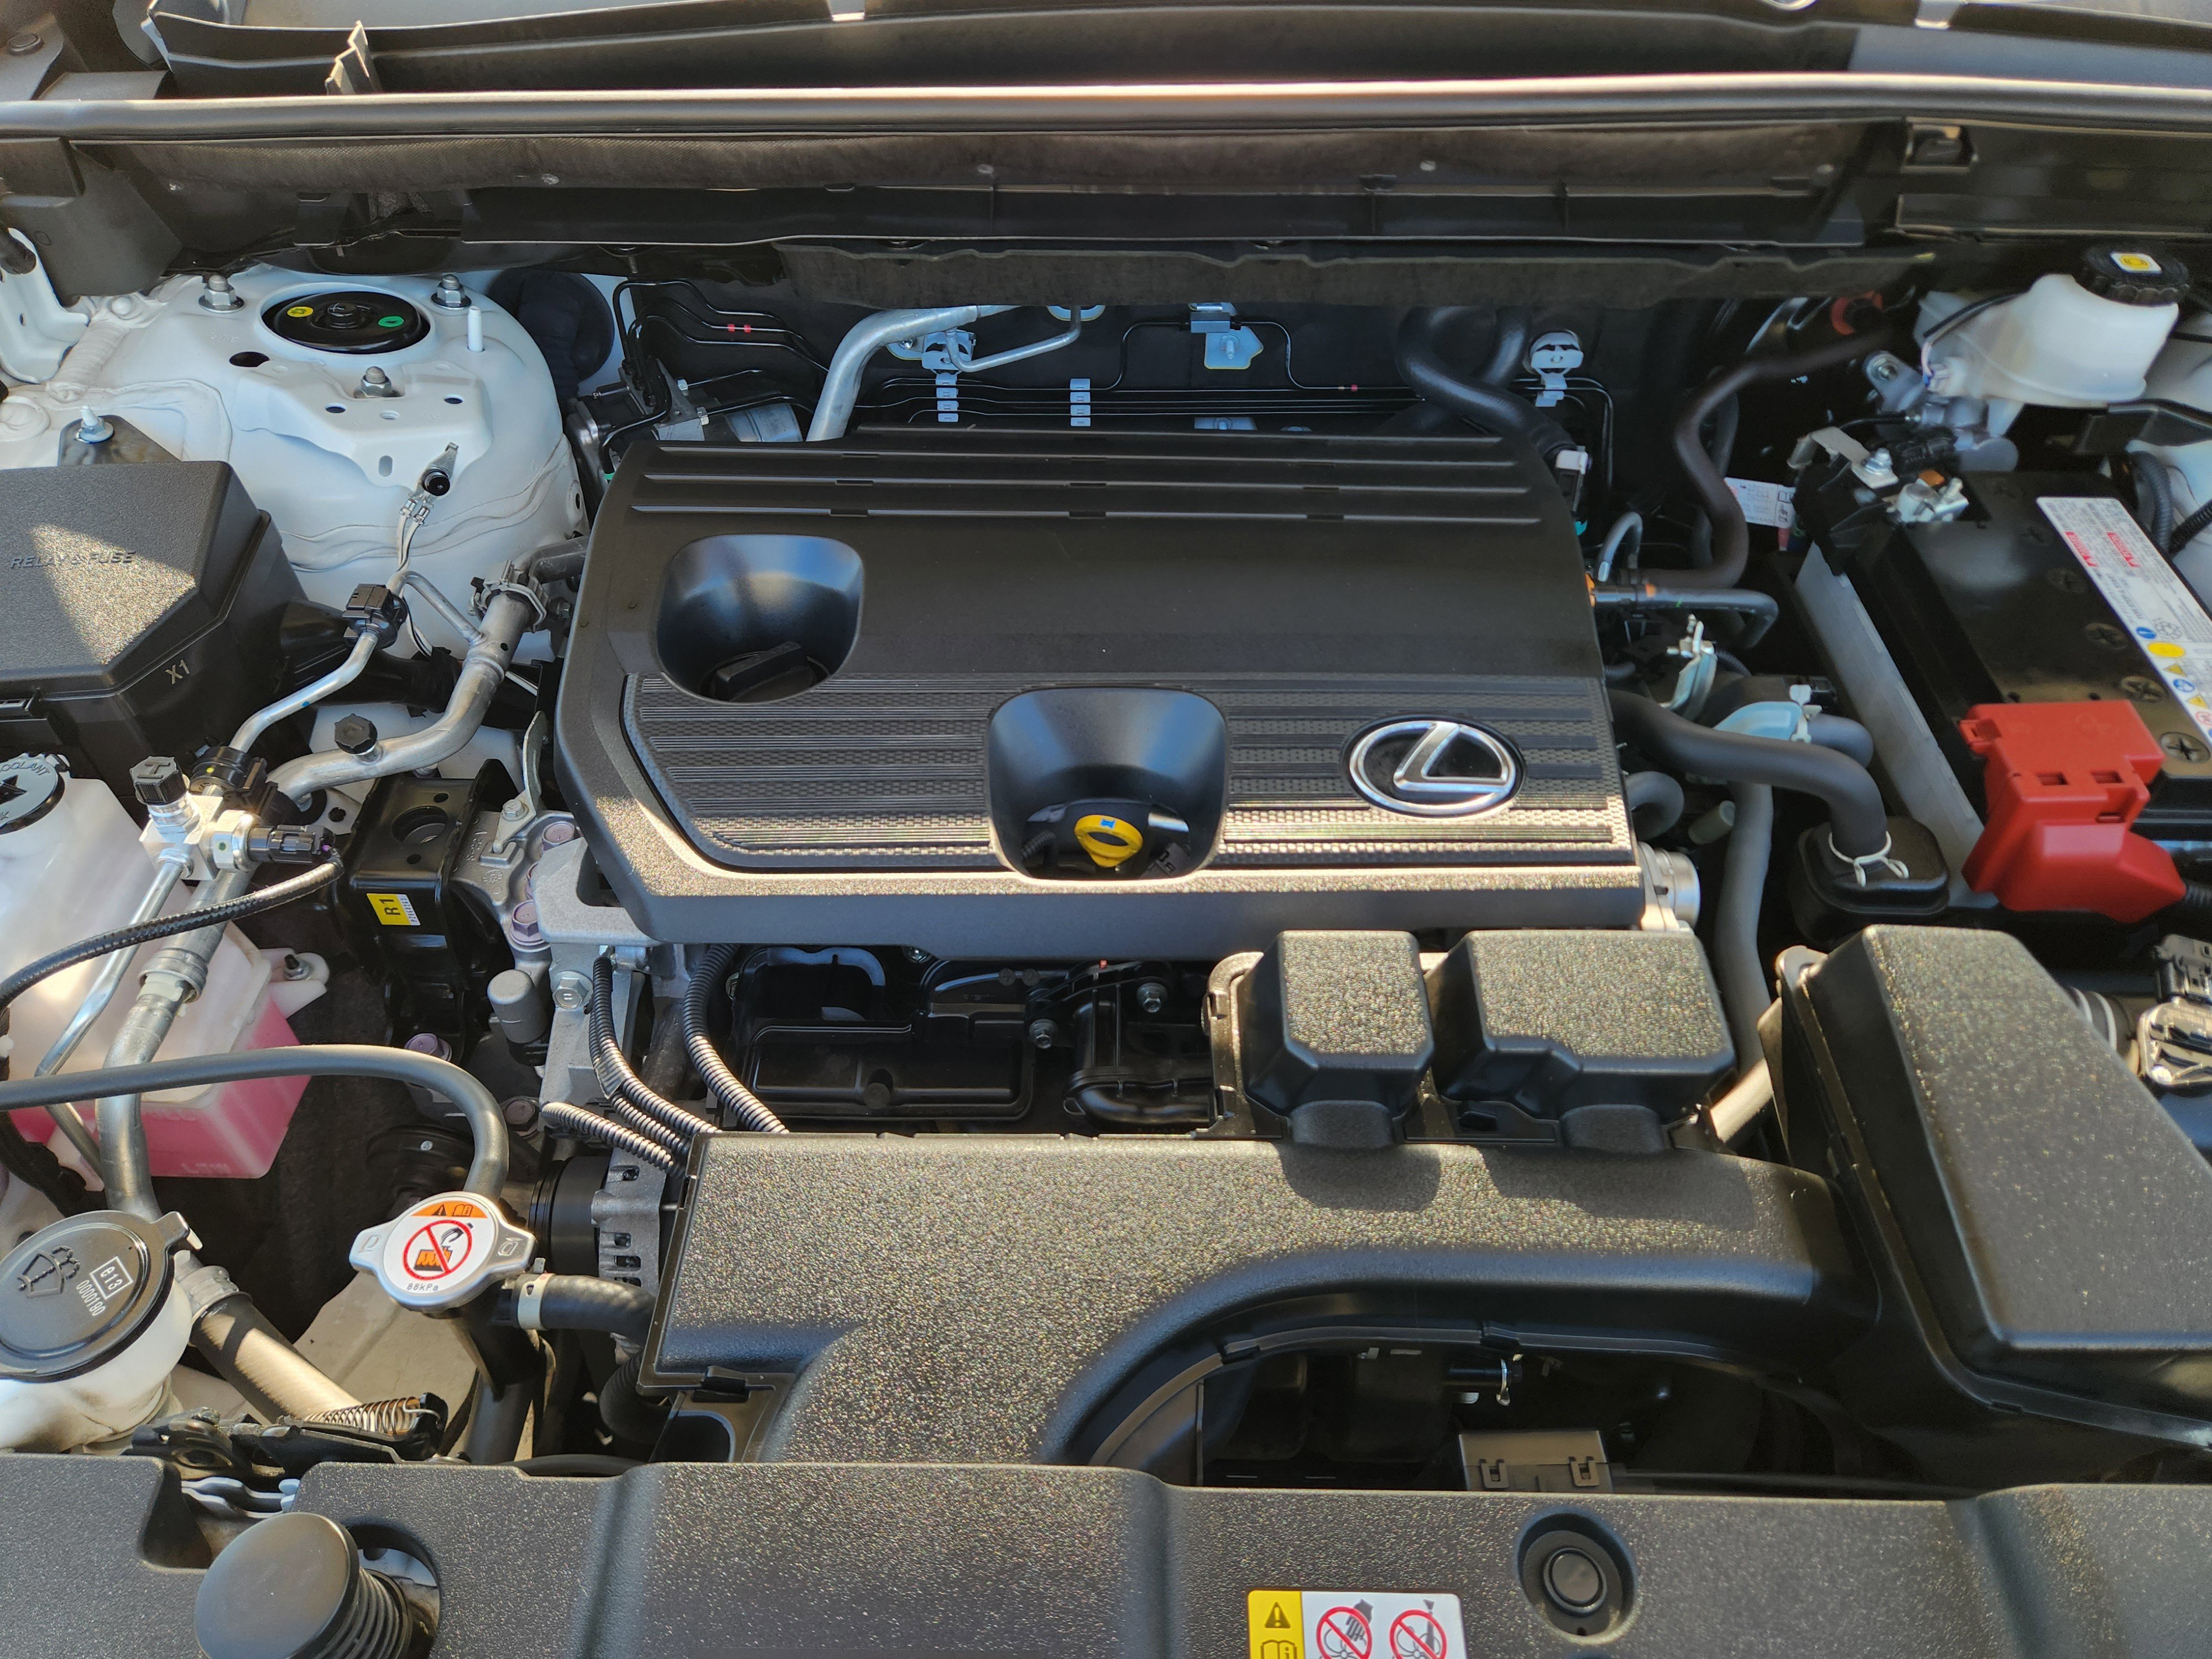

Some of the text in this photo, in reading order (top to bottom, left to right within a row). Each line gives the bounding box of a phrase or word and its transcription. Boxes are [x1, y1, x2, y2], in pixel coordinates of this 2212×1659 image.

[9, 554, 67, 569] RELAY
[165, 659, 190, 685] X1
[0, 760, 51, 776] OOLANT
[137, 761, 171, 779] H
[378, 898, 401, 916] R1
[100, 1266, 123, 1290] e13
[406, 1283, 439, 1291] 88kPa
[76, 1279, 106, 1317] 0000190
